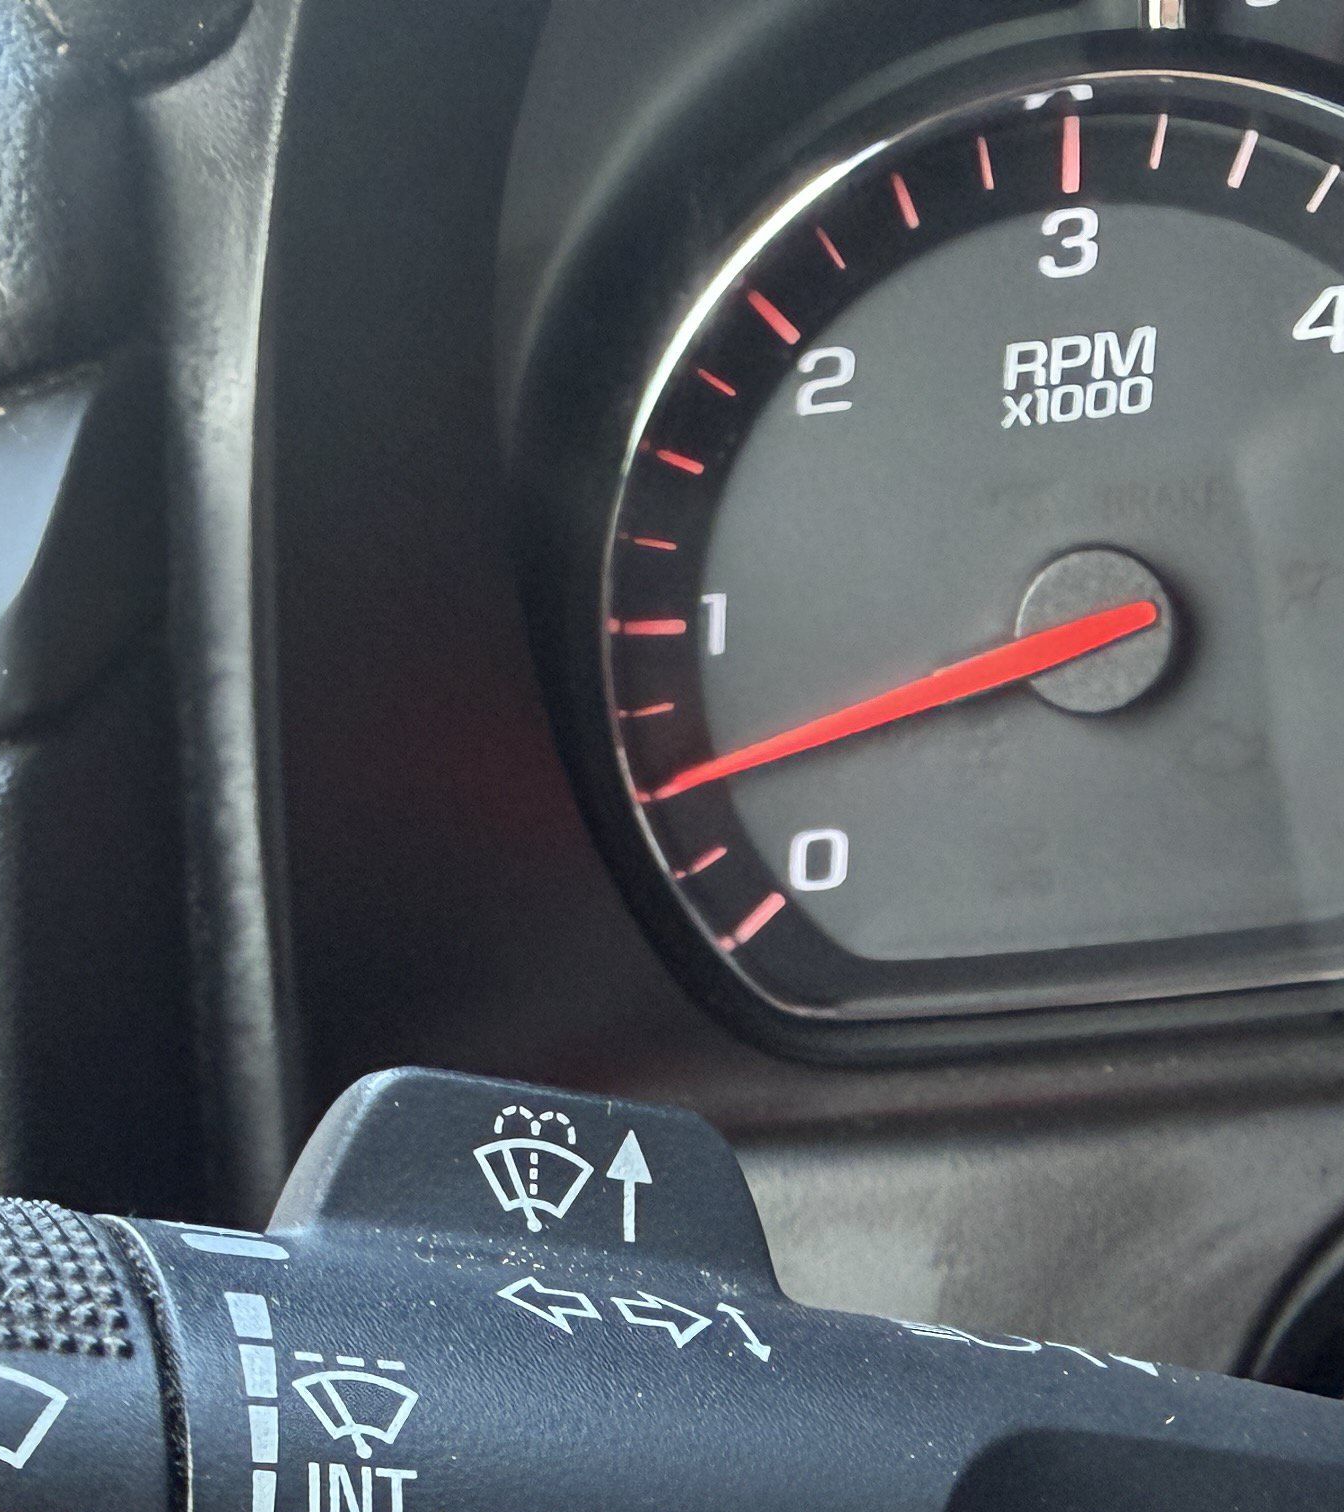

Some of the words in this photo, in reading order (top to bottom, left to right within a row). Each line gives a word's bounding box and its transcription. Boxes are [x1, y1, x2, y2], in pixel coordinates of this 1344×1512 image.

[1038, 207, 1099, 279] 3
[795, 346, 856, 417] 2
[1003, 325, 1157, 389] RPM
[1000, 377, 1153, 428] x1000
[701, 592, 728, 656] 1
[788, 828, 849, 892] 0
